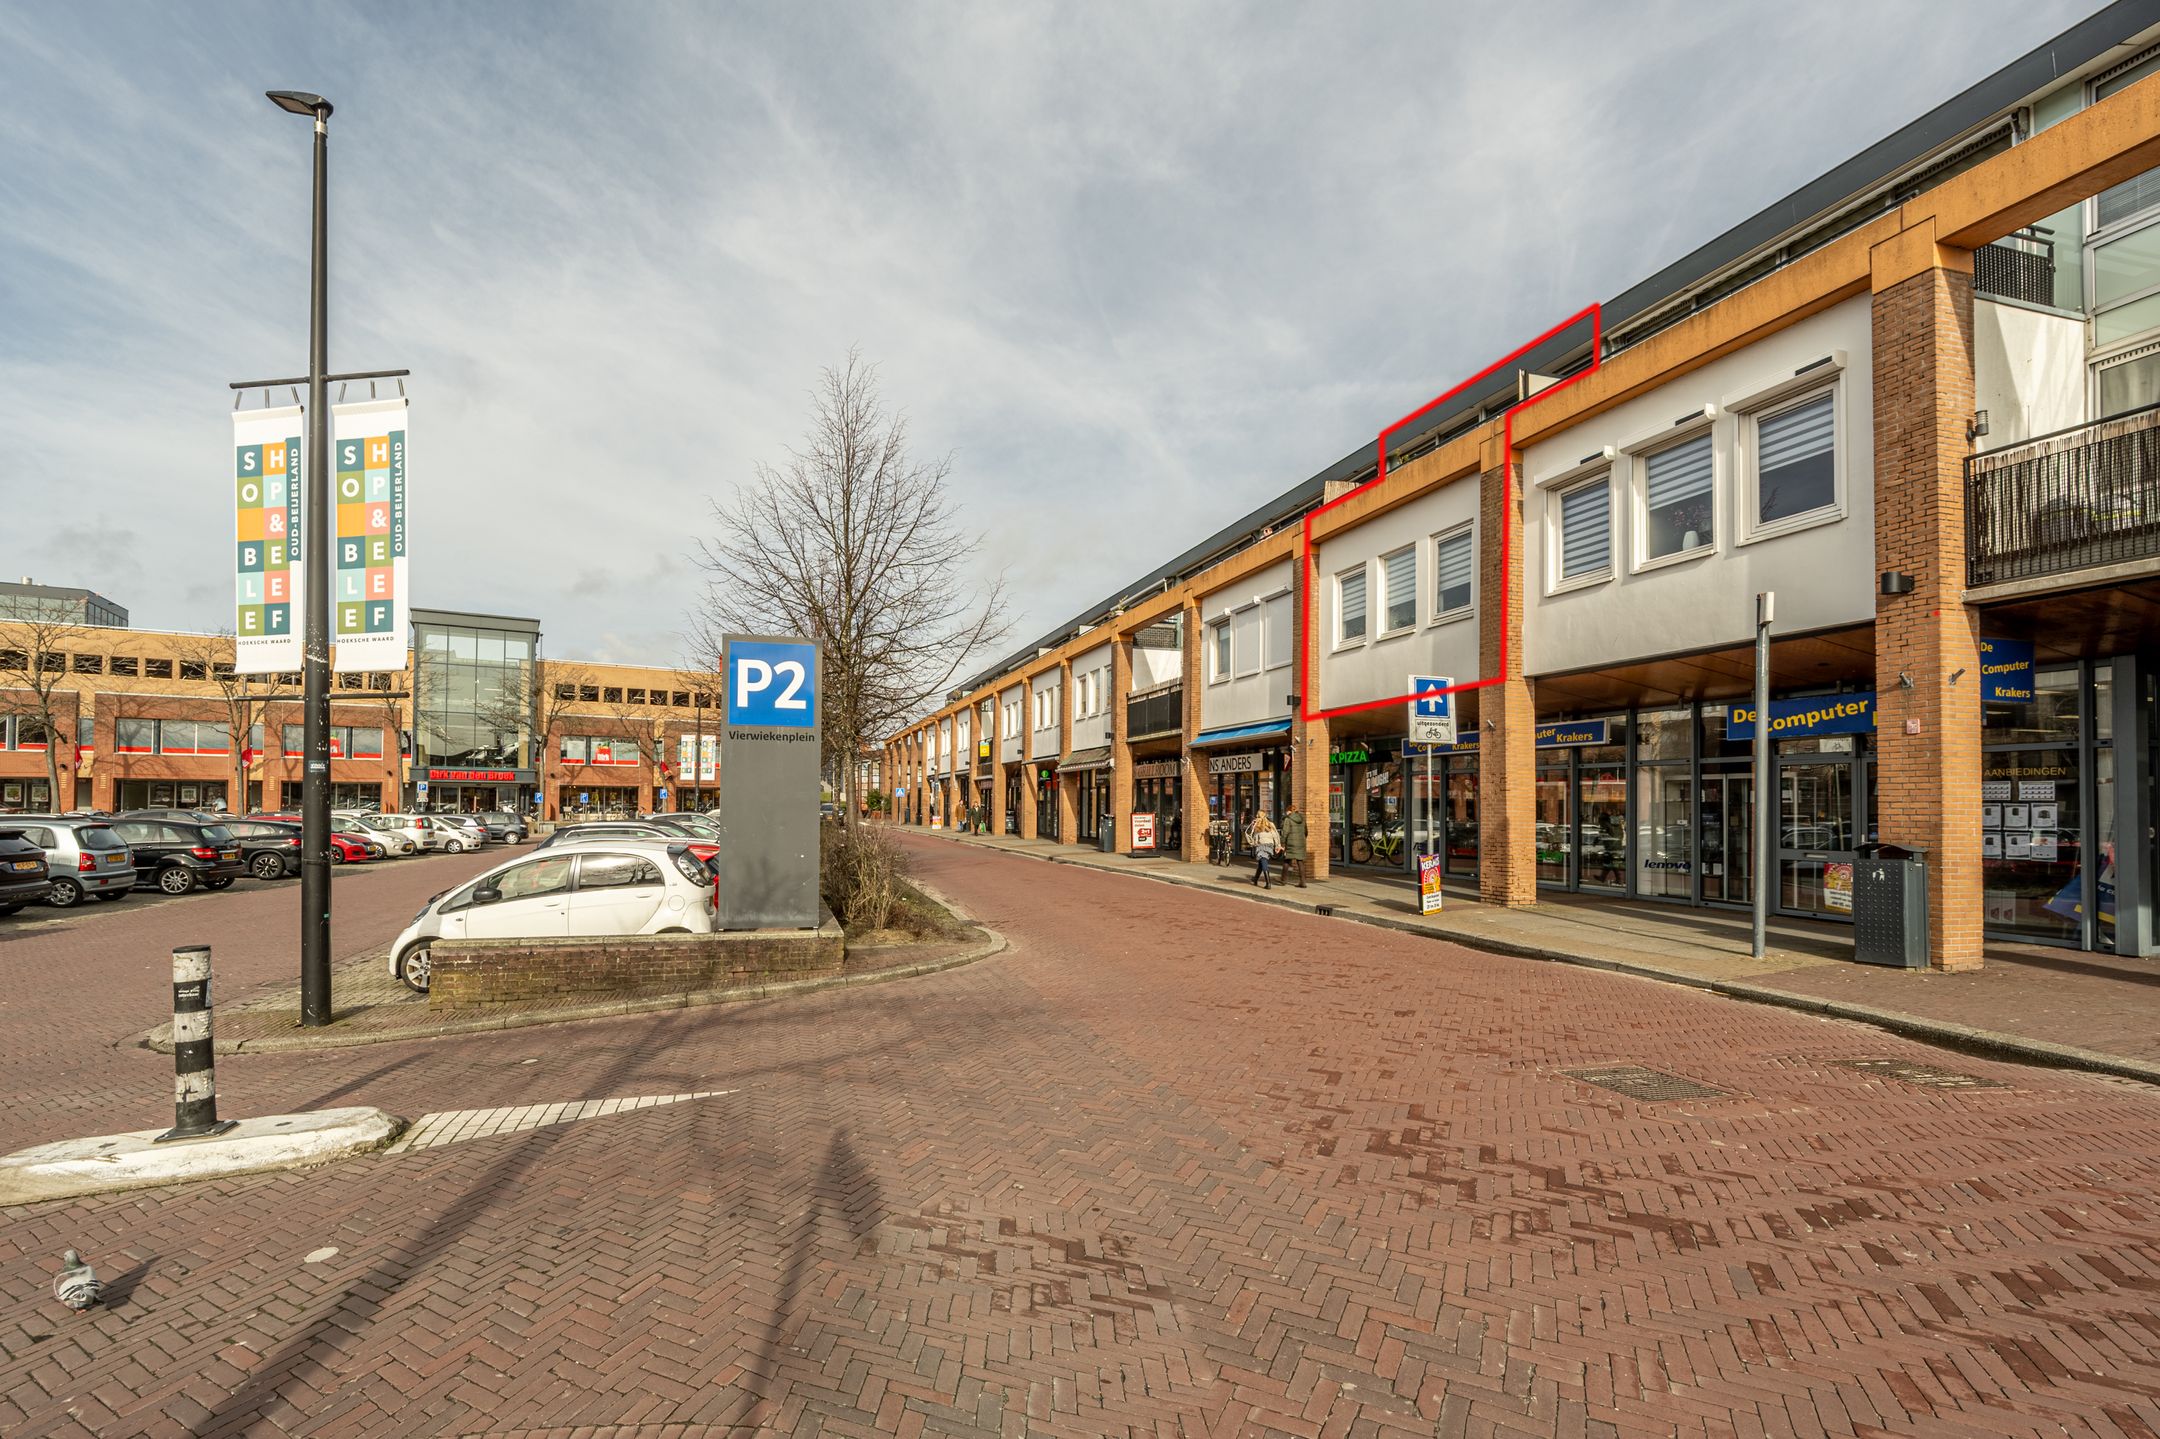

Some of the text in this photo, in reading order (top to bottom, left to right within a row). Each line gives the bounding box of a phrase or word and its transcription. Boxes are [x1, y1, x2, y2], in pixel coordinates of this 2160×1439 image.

[290, 448, 299, 556] OUD-BEIJERLAND
[394, 442, 403, 552] OUD-BEIJERLAND
[1980, 641, 1993, 652] De
[1981, 660, 2029, 675] Computer
[736, 658, 807, 710] P2
[1995, 686, 2031, 698] Krakers
[1733, 708, 1757, 724] De
[1416, 720, 1450, 728] uitgezonderd
[728, 730, 815, 743] Vierwiekenplein
[1556, 731, 1593, 743] Krakers
[1452, 741, 1480, 751] Krakers
[1338, 750, 1367, 764] PIZZA
[1220, 756, 1252, 771] ANDERS
[429, 769, 449, 780] Dirk
[450, 771, 468, 780] van
[470, 770, 486, 780] den
[1984, 767, 2067, 777] AANBIEDINGEN
[1644, 859, 1692, 870] lenovo
